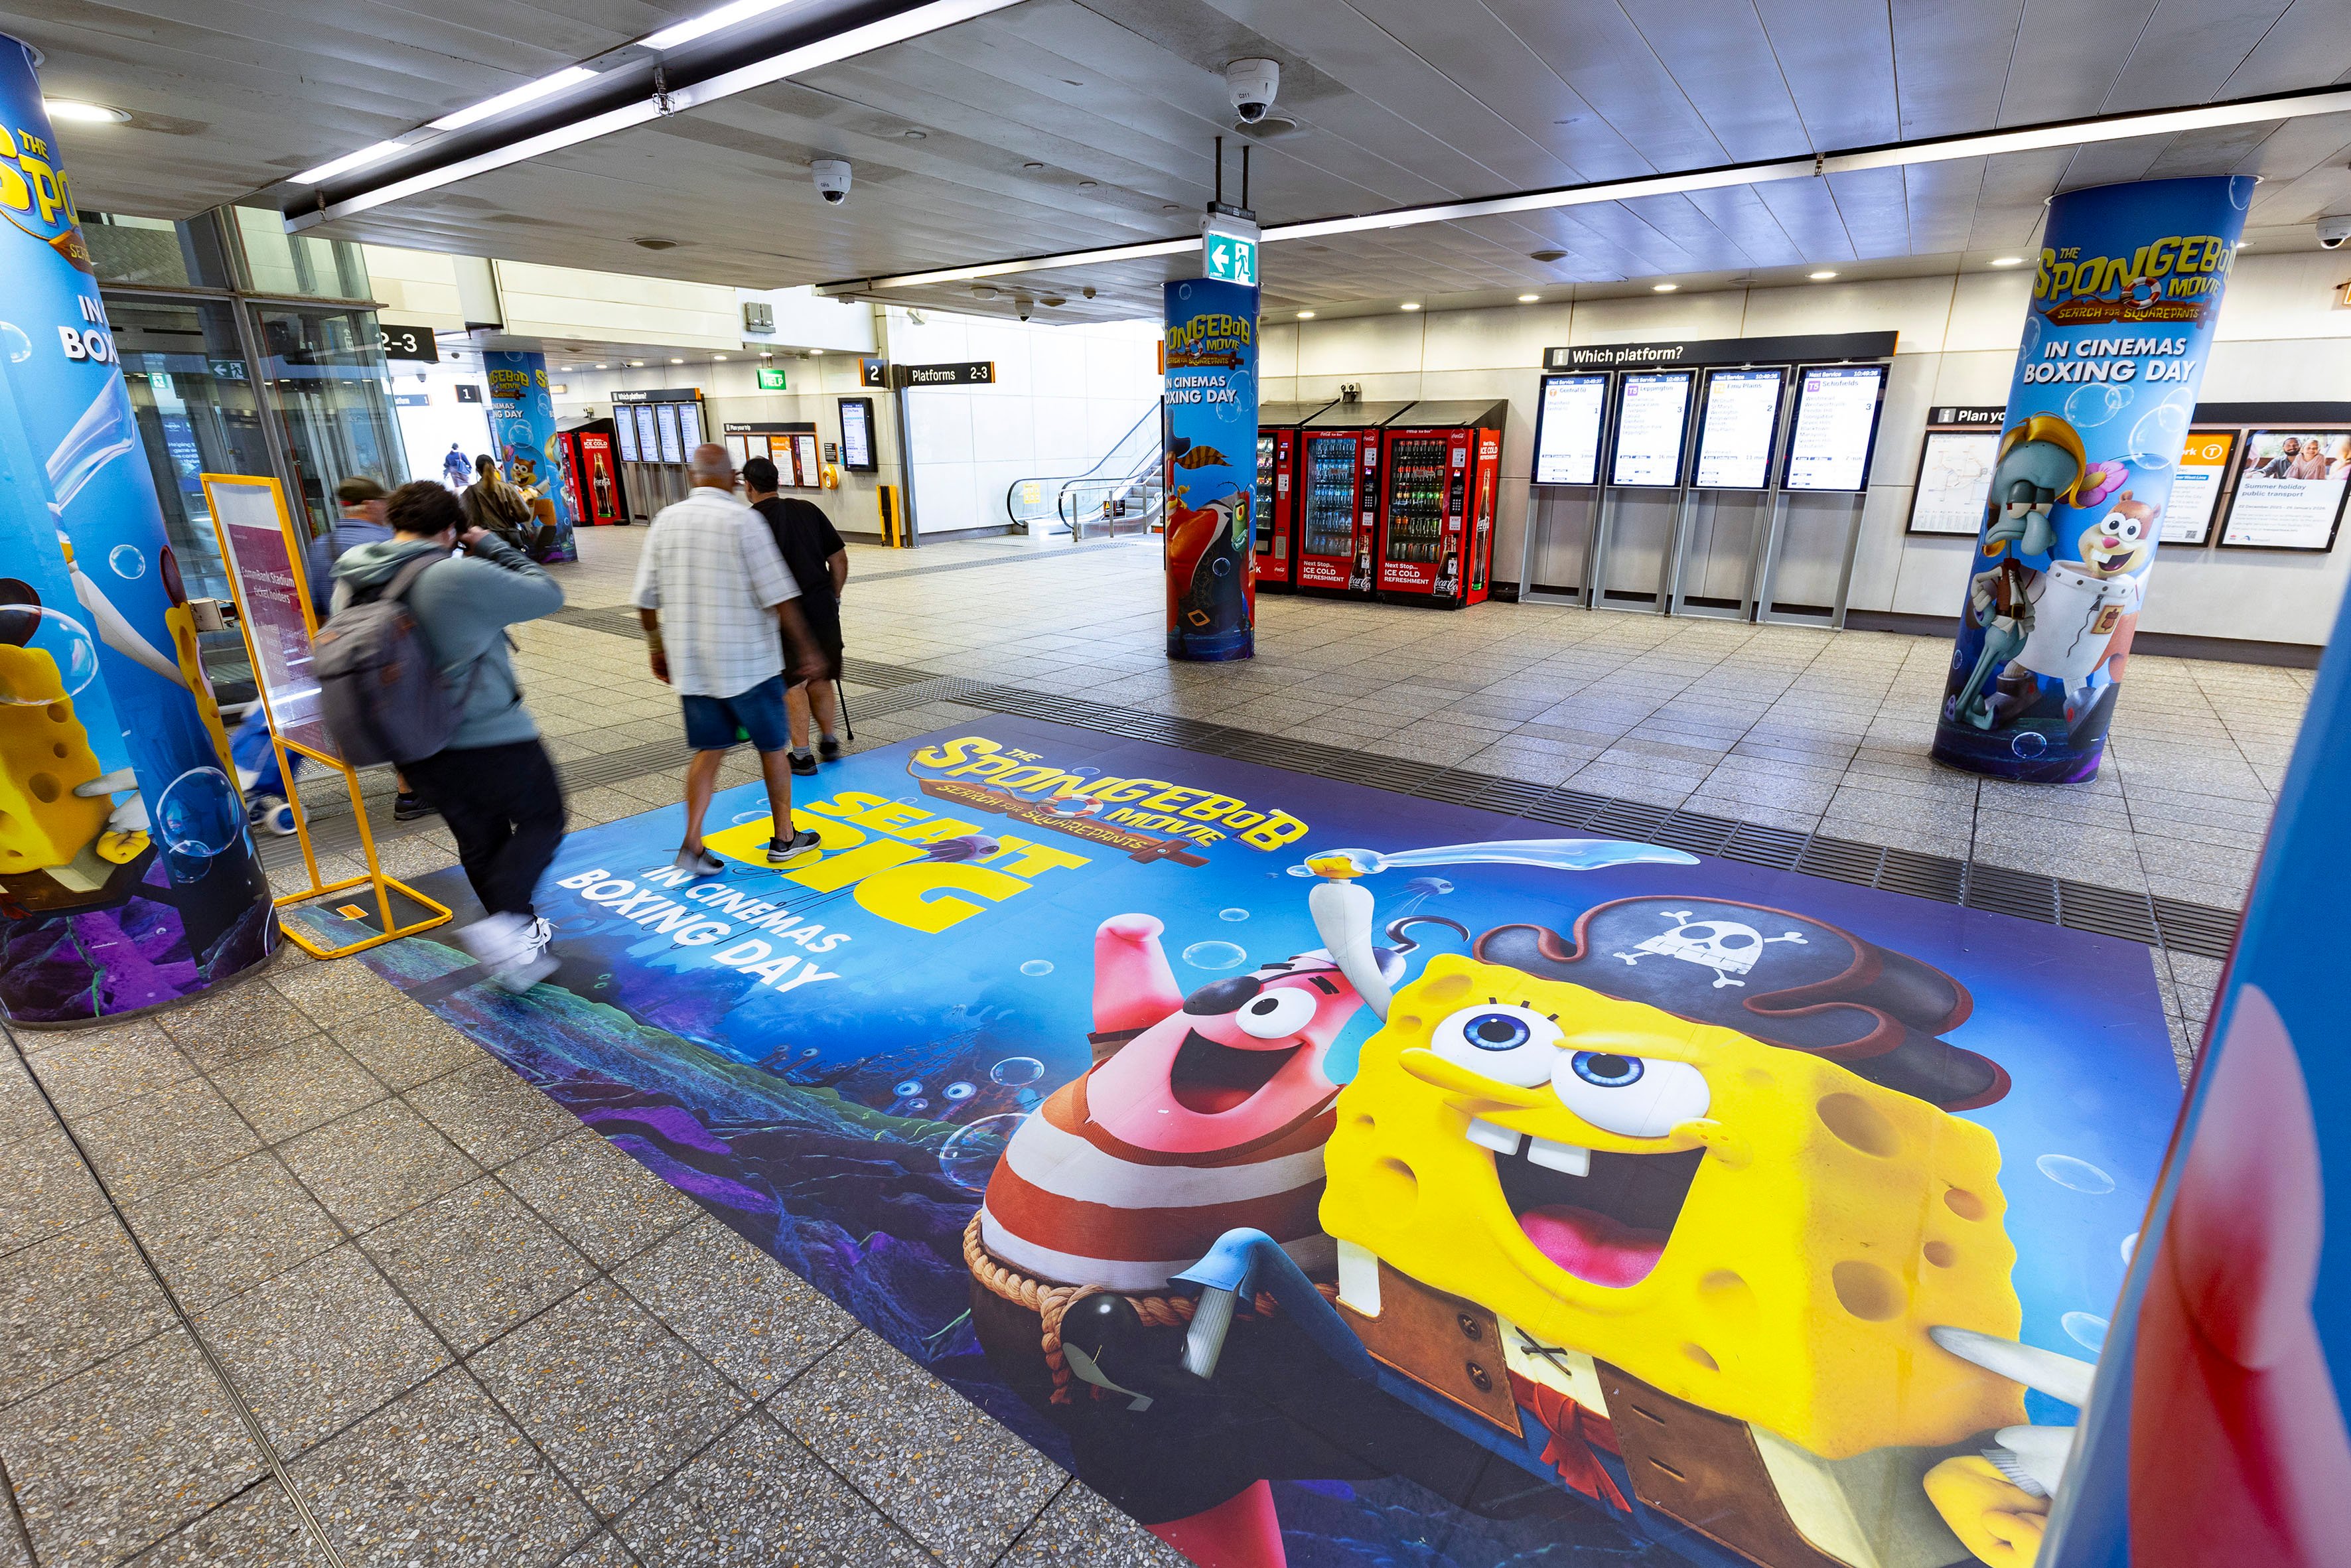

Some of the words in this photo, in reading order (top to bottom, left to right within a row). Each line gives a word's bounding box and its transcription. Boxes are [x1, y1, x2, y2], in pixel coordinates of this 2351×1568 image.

[17, 127, 50, 161] THE
[2060, 247, 2081, 259] THE
[2167, 276, 2220, 297] MOVIE
[2058, 307, 2102, 319] SEARCH
[2123, 307, 2199, 321] SQUAREPANTS
[376, 332, 417, 352] 2-3
[1206, 338, 1240, 351] MOVIE
[2044, 340, 2069, 358] IN
[2075, 338, 2187, 356] CINEMAS
[1573, 350, 1613, 363] Which
[1616, 346, 1683, 364] platform?
[870, 366, 879, 380] 2
[912, 369, 956, 382] Platforms
[970, 366, 987, 379] 2-3
[2024, 360, 2136, 383] BOXING
[2145, 360, 2196, 381] DAY
[764, 378, 783, 386] HELP
[1175, 376, 1226, 388] CINEMAS
[463, 388, 470, 399] 1
[1206, 390, 1237, 402] DAY
[1958, 410, 1987, 421] Plan
[241, 566, 271, 583] CommBank
[271, 572, 295, 588] Stadium
[253, 585, 269, 599] ticket
[269, 589, 291, 604] holders
[1004, 748, 1044, 762] THE
[925, 736, 1310, 853] SPONGEBOB
[804, 792, 983, 844] SEA
[935, 784, 999, 806] SEARCH
[1000, 801, 1023, 813] FOR
[1021, 809, 1147, 850] SQUAREPANTS
[1104, 808, 1227, 848] MOVIE
[640, 864, 701, 888] IN
[684, 883, 852, 954] CINEMAS
[555, 869, 732, 946] BOXING
[710, 938, 843, 993] DAY
